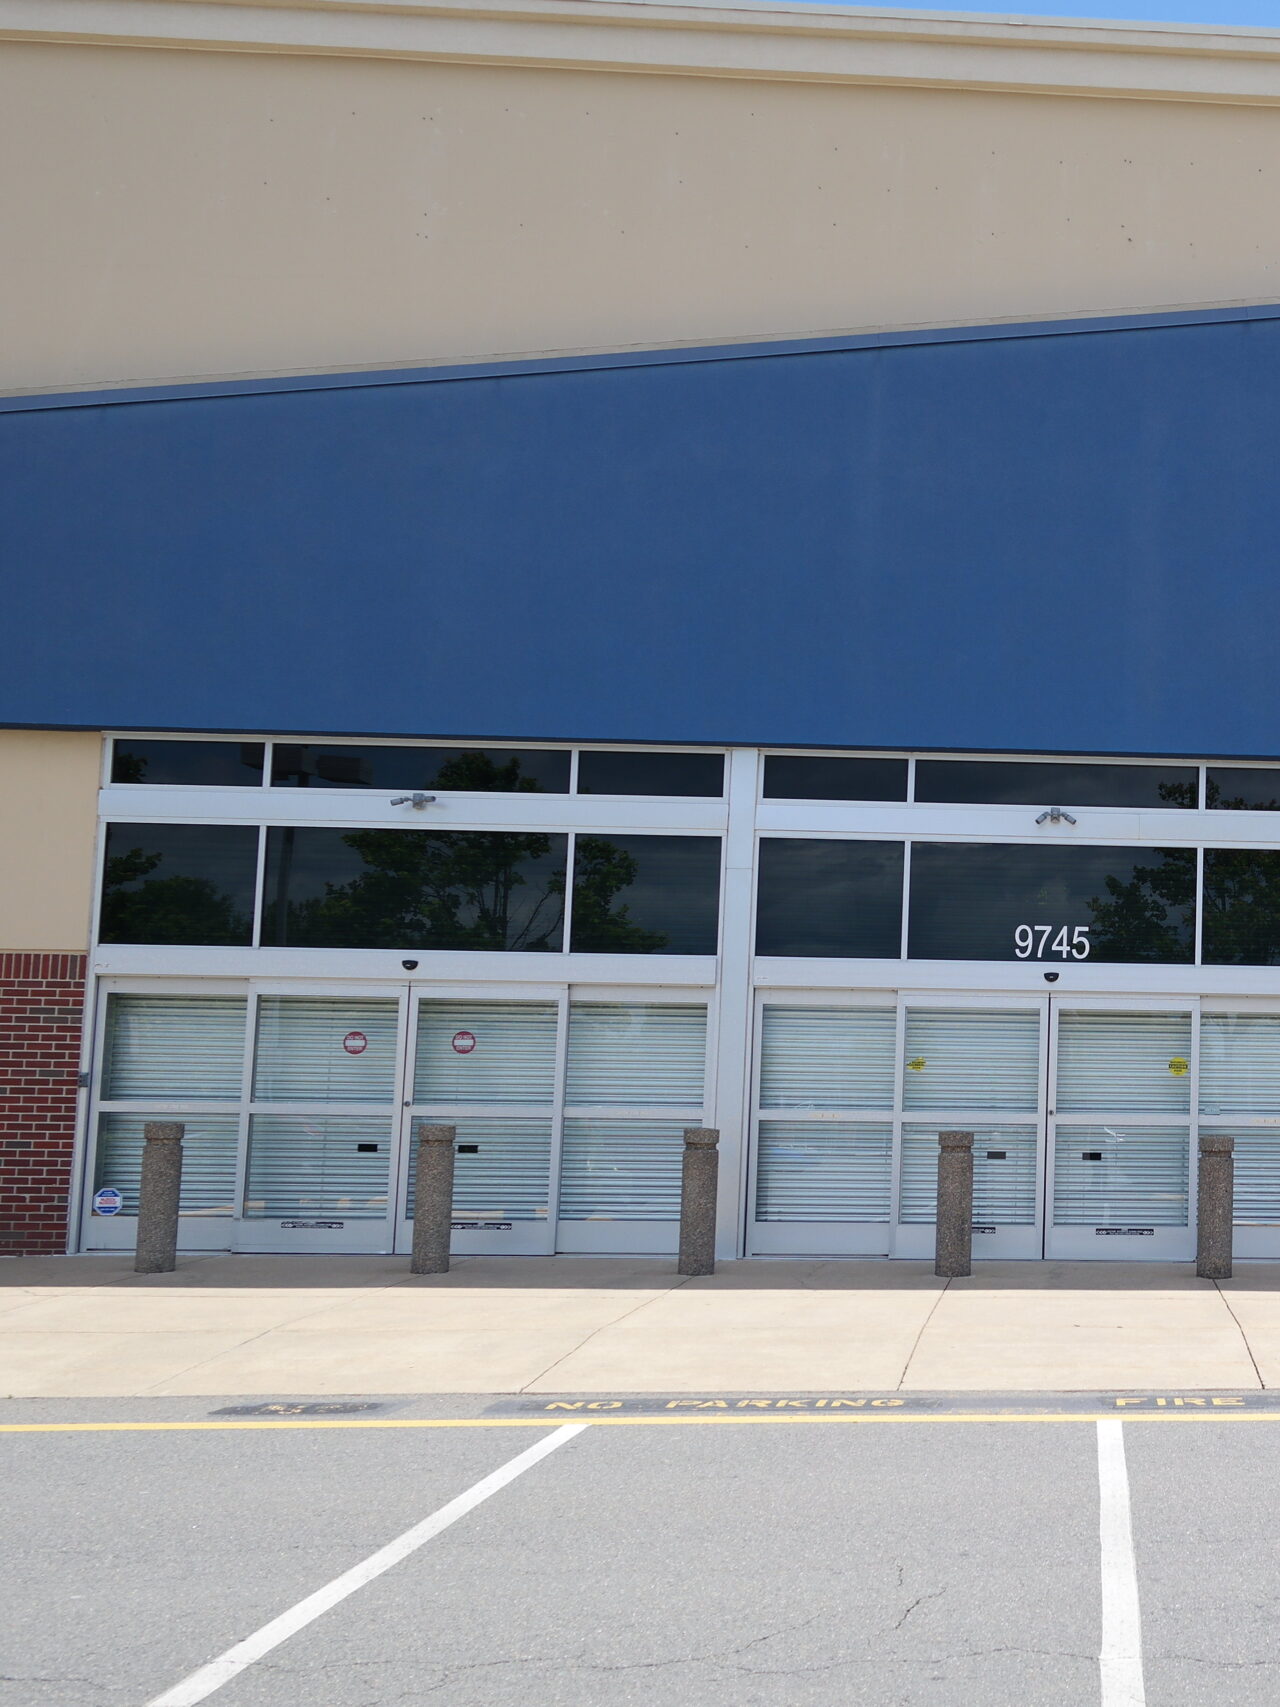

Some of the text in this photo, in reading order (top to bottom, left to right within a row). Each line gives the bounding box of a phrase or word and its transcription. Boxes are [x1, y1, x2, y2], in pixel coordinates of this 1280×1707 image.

[1014, 924, 1090, 960] 9745
[544, 1399, 905, 1410] NO PARKING
[1115, 1397, 1246, 1406] FIRE
